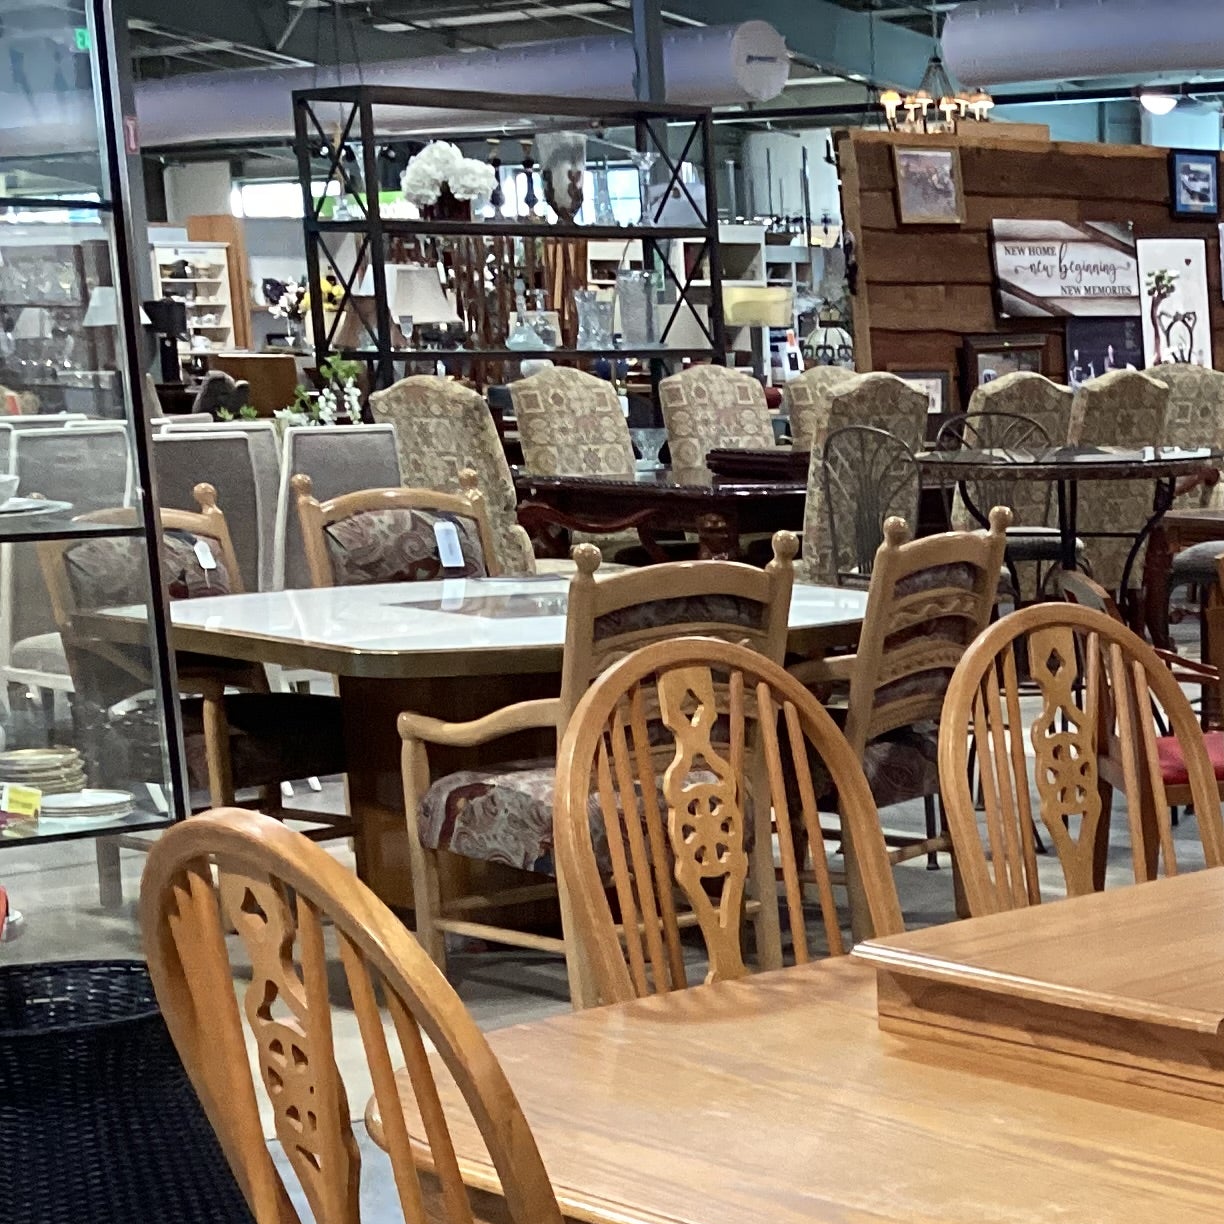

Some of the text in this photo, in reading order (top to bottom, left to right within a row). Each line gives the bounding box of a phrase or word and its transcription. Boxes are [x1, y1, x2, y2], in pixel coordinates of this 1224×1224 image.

[1004, 246, 1057, 256] NEW HOME
[1019, 242, 1131, 284] new beginning
[1061, 285, 1132, 296] NEW MEMORIES
